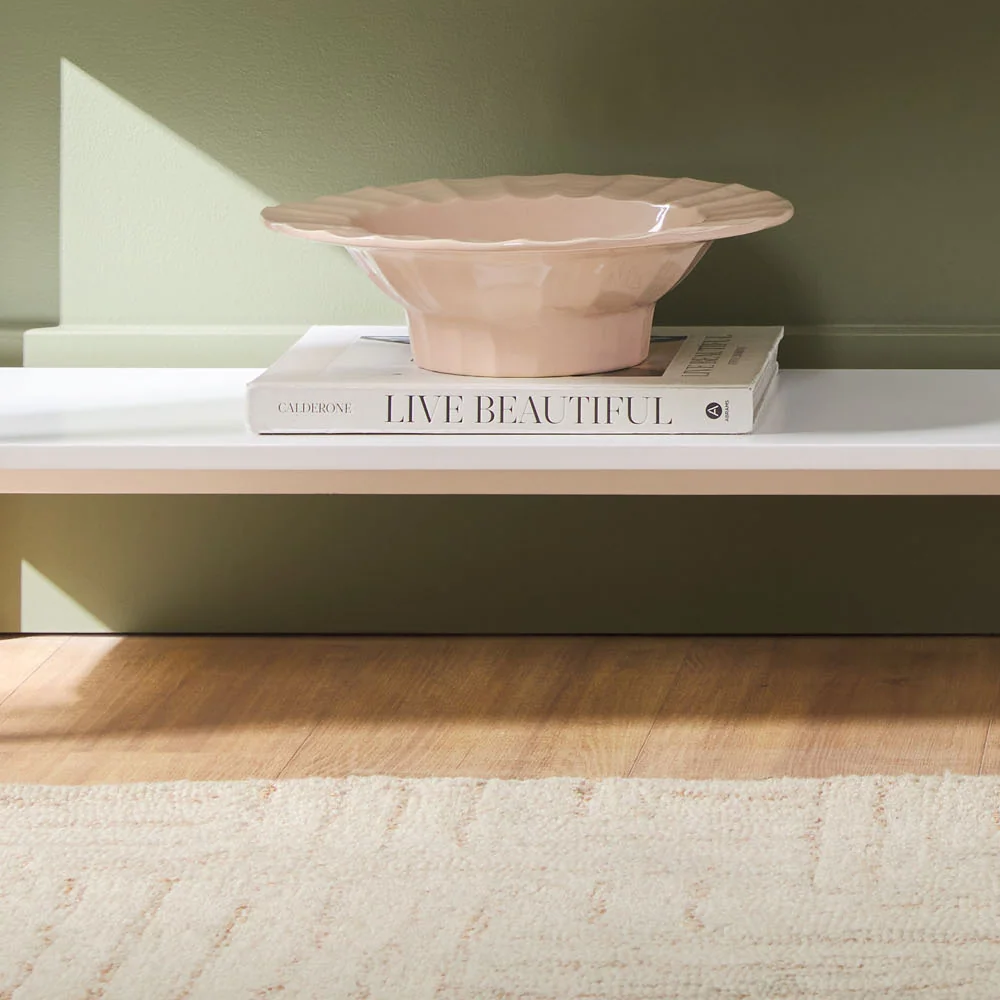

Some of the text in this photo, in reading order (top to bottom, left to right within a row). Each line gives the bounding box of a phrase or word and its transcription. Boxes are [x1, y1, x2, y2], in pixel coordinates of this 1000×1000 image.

[277, 401, 353, 415] CALDERONE
[384, 394, 673, 425] LIVE BEAUTIFUL
